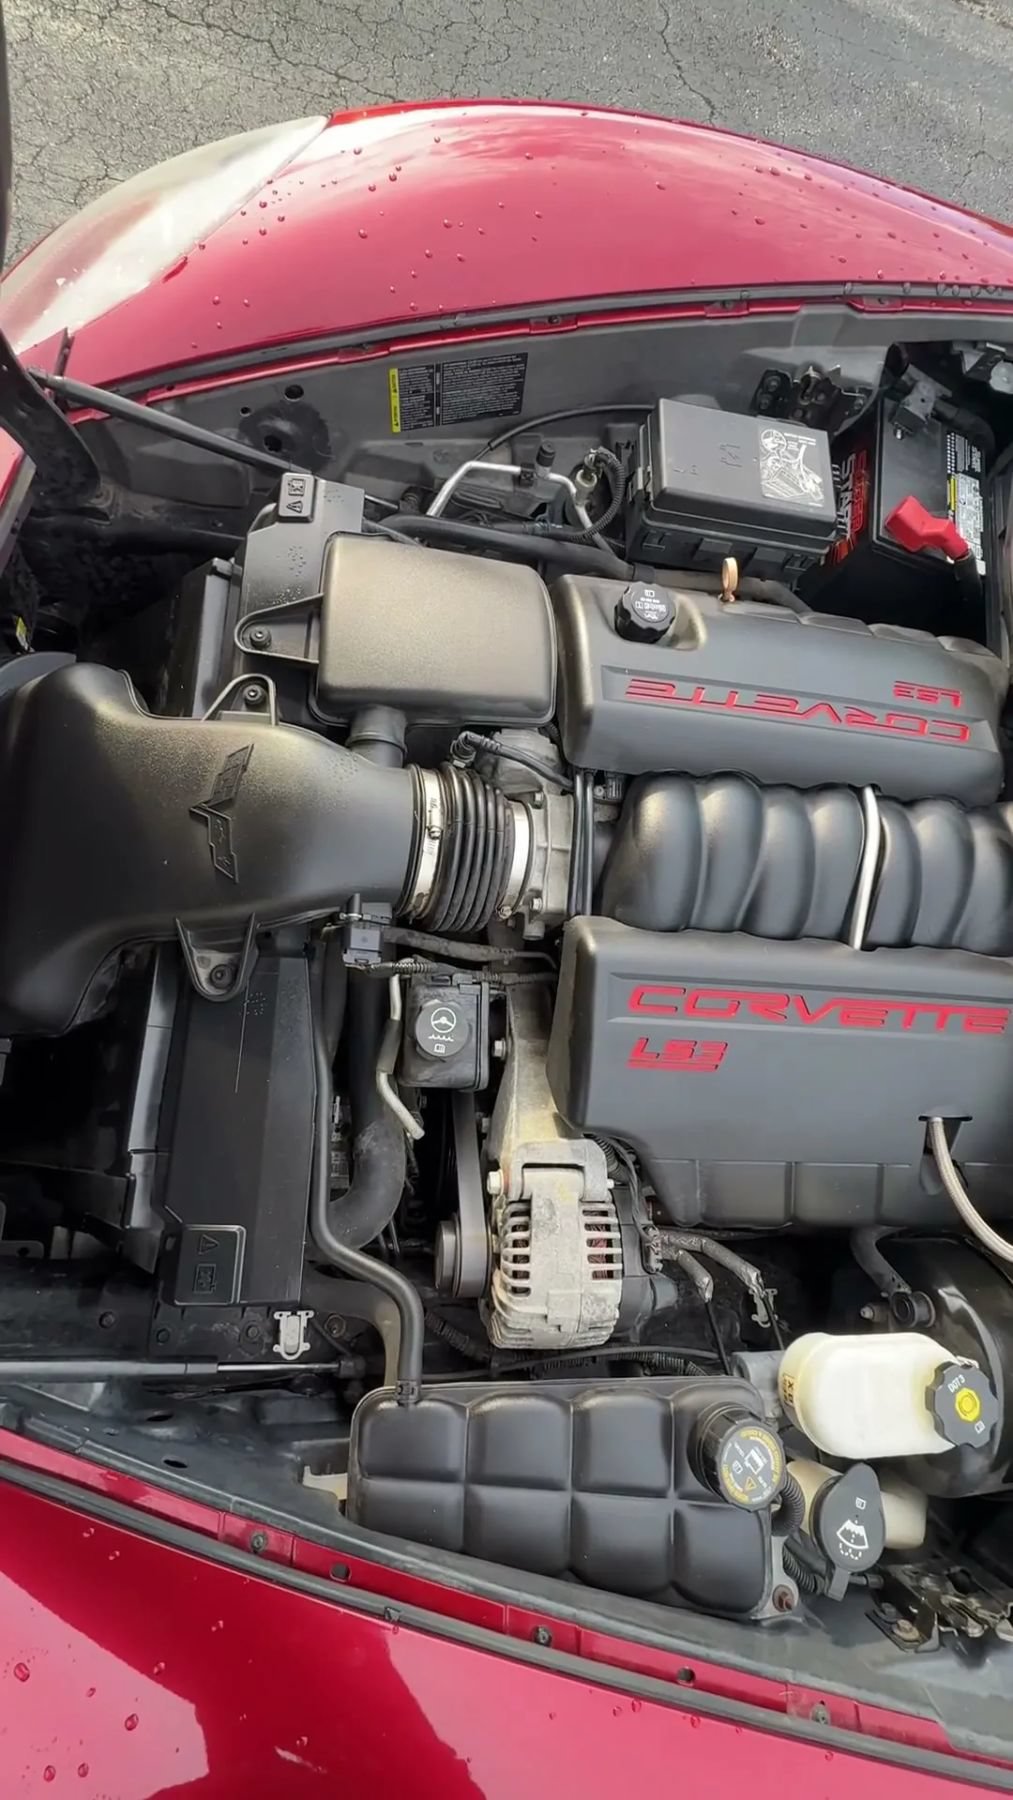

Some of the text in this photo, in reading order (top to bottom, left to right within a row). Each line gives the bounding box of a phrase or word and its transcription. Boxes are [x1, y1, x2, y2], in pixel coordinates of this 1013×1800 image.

[625, 679, 970, 742] CORVETTE
[892, 680, 962, 708] LS3
[628, 985, 1010, 1034] CORVETTE
[628, 1037, 728, 1071] LS3
